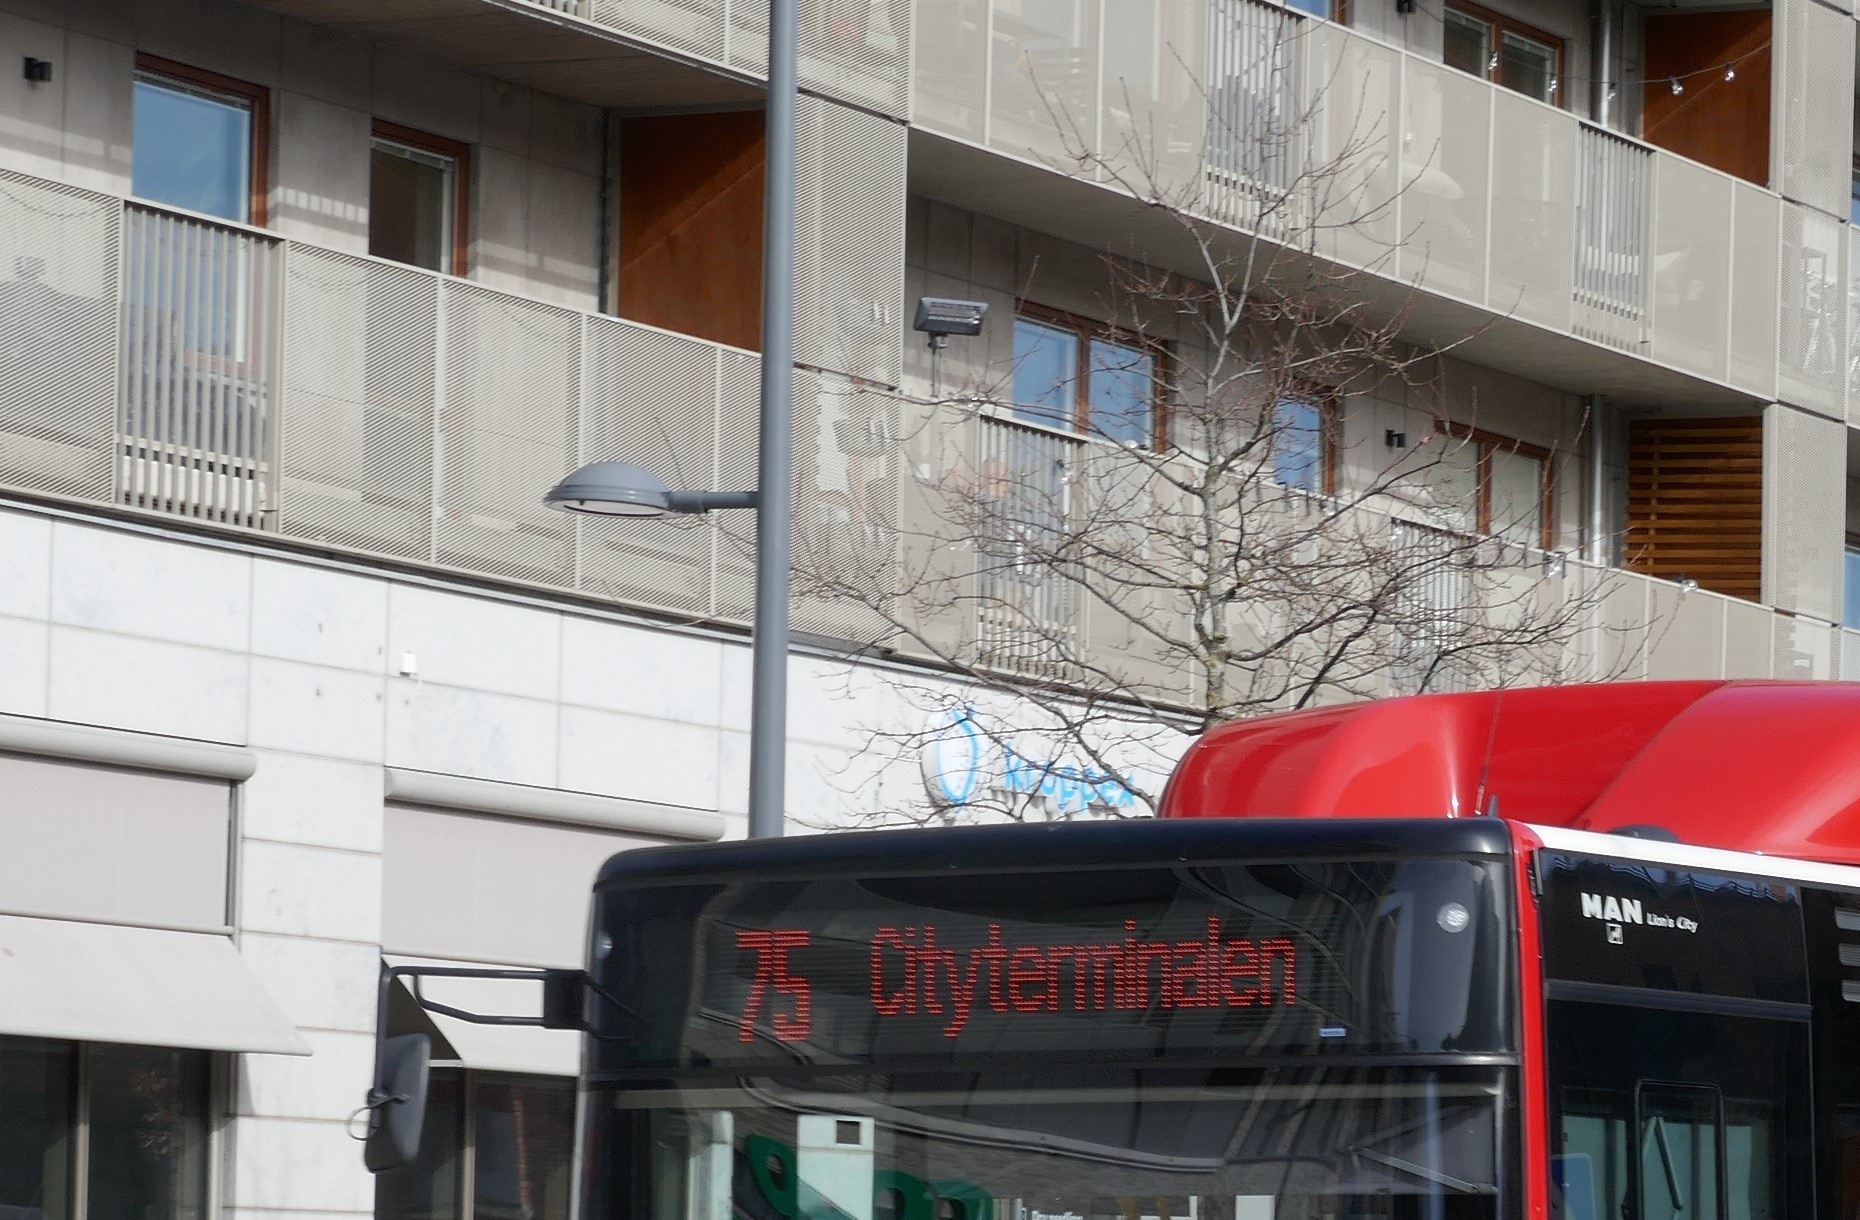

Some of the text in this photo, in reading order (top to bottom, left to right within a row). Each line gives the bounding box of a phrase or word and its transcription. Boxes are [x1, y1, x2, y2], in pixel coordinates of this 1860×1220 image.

[1580, 892, 1699, 934] MAN Lion's City
[735, 916, 1296, 1042] 75 Cityterminalen
